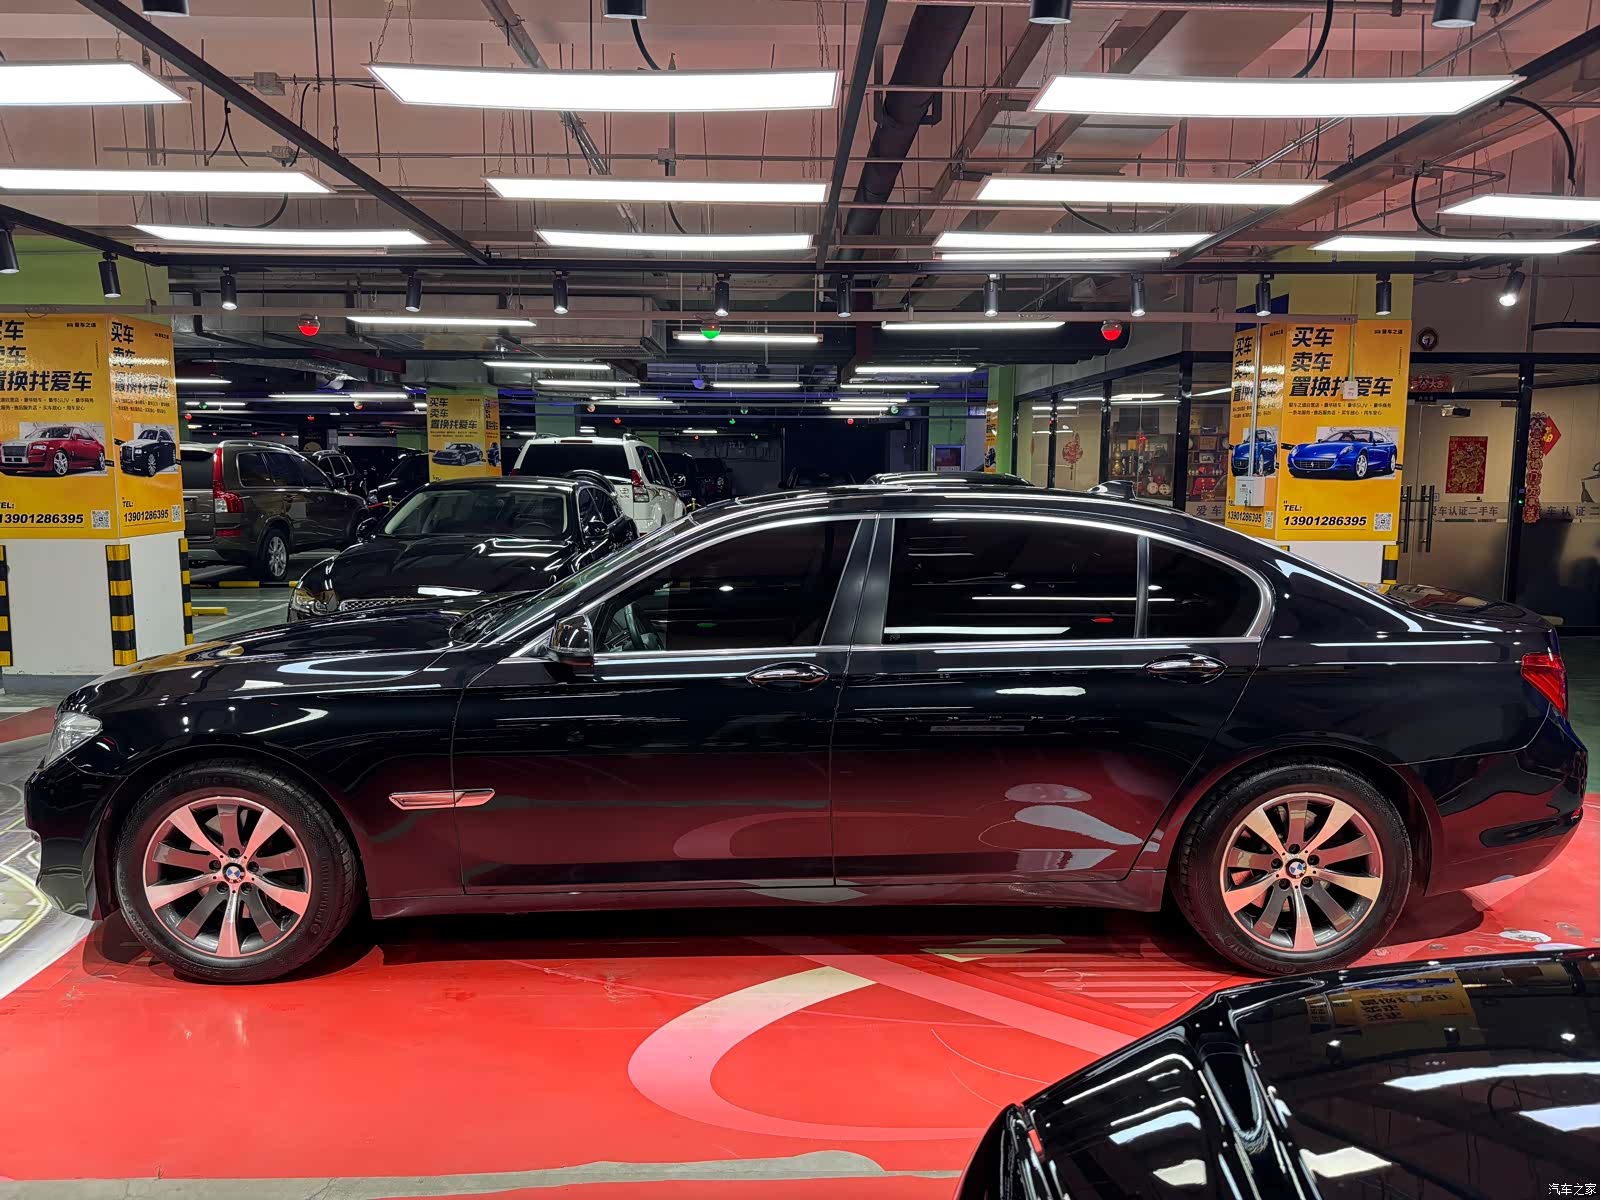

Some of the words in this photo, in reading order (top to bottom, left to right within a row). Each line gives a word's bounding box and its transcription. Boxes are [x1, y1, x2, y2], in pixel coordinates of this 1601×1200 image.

[0, 320, 24, 341] 车
[111, 321, 135, 344] 买车
[1292, 327, 1335, 348] 买车
[0, 345, 26, 366] 车
[1235, 336, 1253, 357] 买车
[1290, 351, 1333, 372] 卖车
[0, 501, 14, 509] EL:
[1283, 504, 1302, 512] TEL:
[124, 510, 169, 522] 13901286395
[1228, 510, 1262, 523] 13901286395
[1283, 516, 1367, 526] 13901286395
